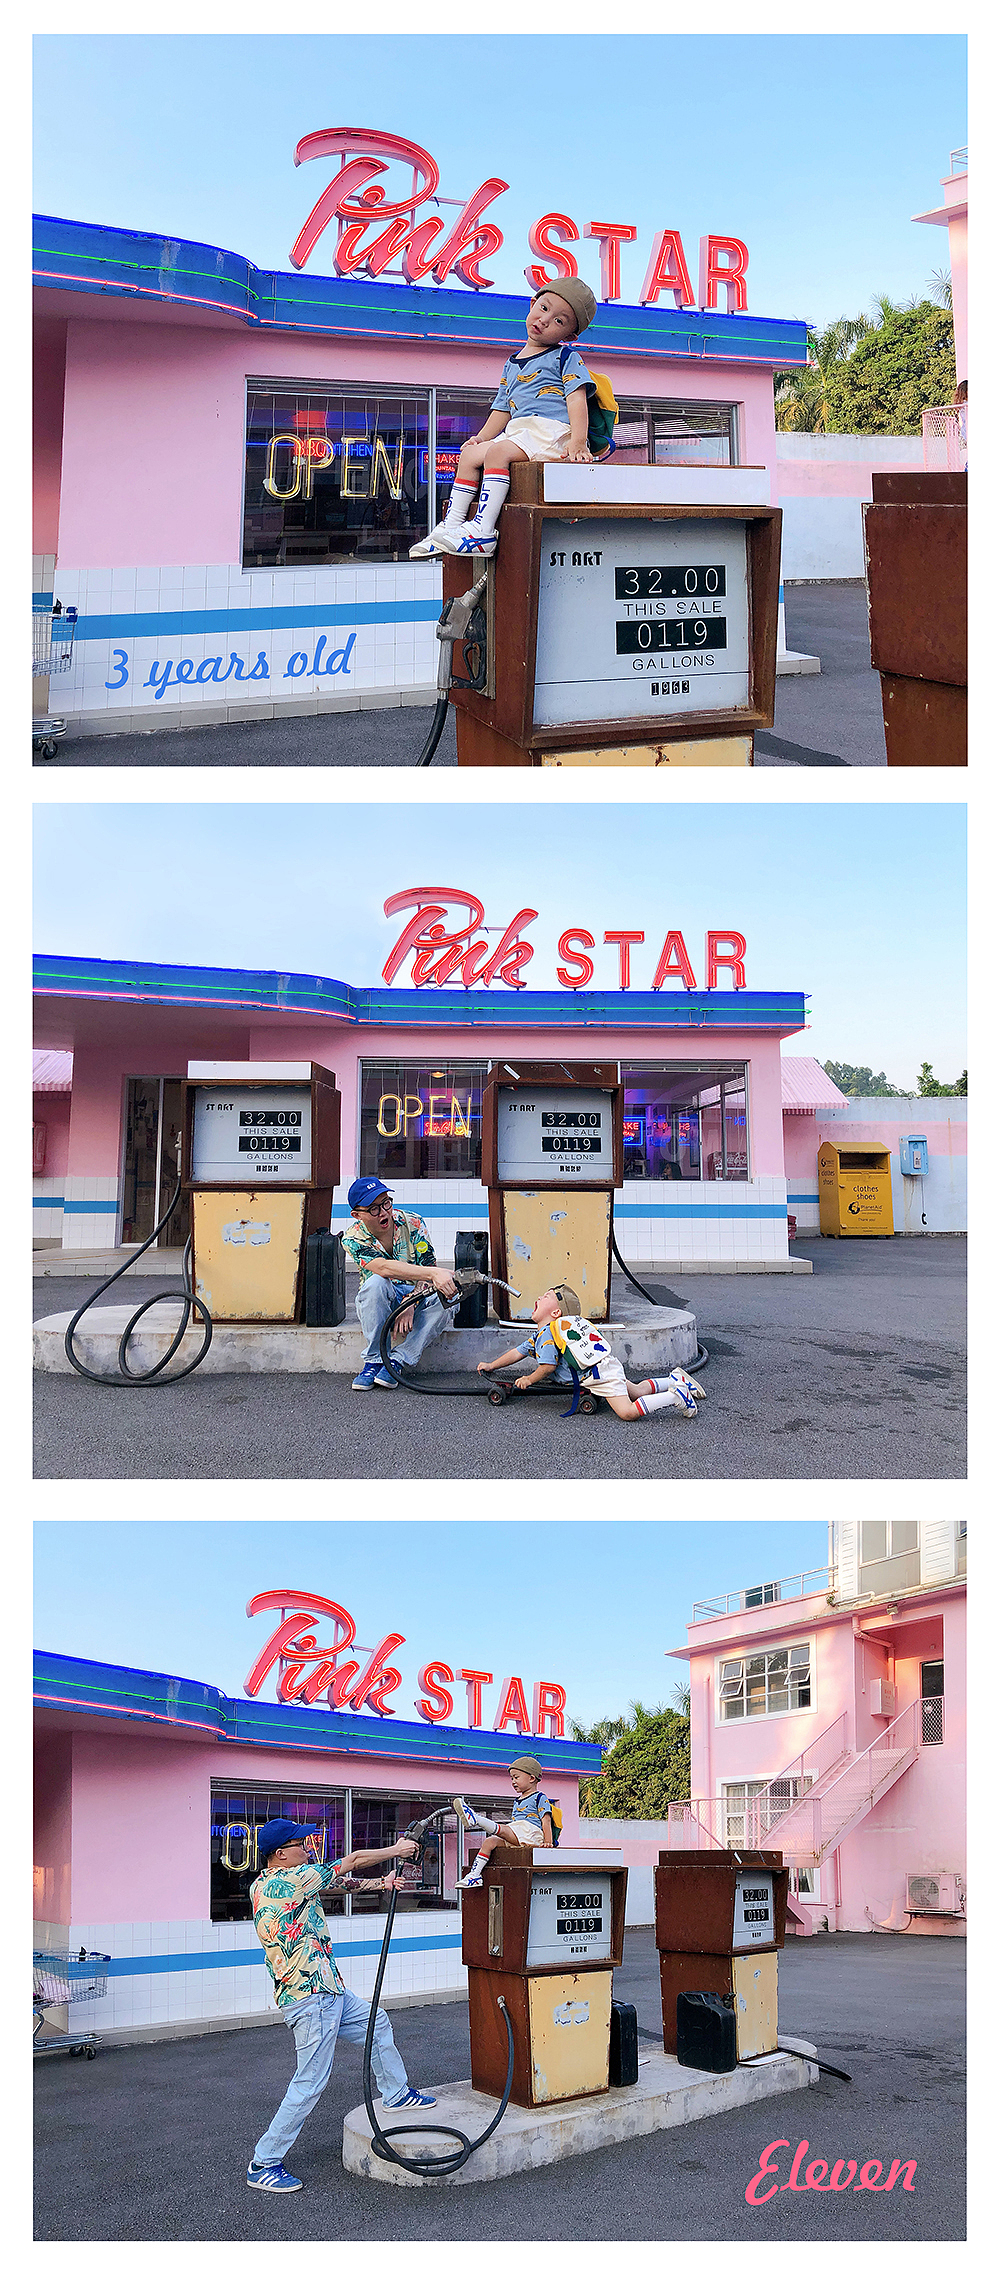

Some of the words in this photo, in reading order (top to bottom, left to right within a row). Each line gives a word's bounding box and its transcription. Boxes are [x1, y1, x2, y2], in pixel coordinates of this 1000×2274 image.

[288, 127, 510, 289] Pink
[524, 213, 749, 312] STAR
[263, 433, 405, 500] OPEN
[474, 483, 491, 525] LOVE
[624, 568, 719, 595] 32.00
[623, 602, 667, 616] THIS
[676, 600, 722, 615] SALE
[637, 620, 708, 648] 0119
[632, 654, 716, 671] GALLONS
[651, 680, 690, 696] 1963
[382, 886, 539, 987] Pink
[556, 928, 748, 989] STAR
[244, 1112, 298, 1125] 32.00
[377, 1093, 472, 1138] OPEN
[546, 1114, 597, 1126] 32.00
[249, 1137, 290, 1150] 0119
[552, 1138, 591, 1150] 0119
[853, 1184, 879, 1193] clothes
[856, 1193, 876, 1201] shoes
[243, 1590, 407, 1716] Pink
[414, 1661, 567, 1737] STAR
[560, 1895, 600, 1908] 32.00
[565, 1919, 595, 1932] 0119
[563, 1934, 598, 1942] GALLONS
